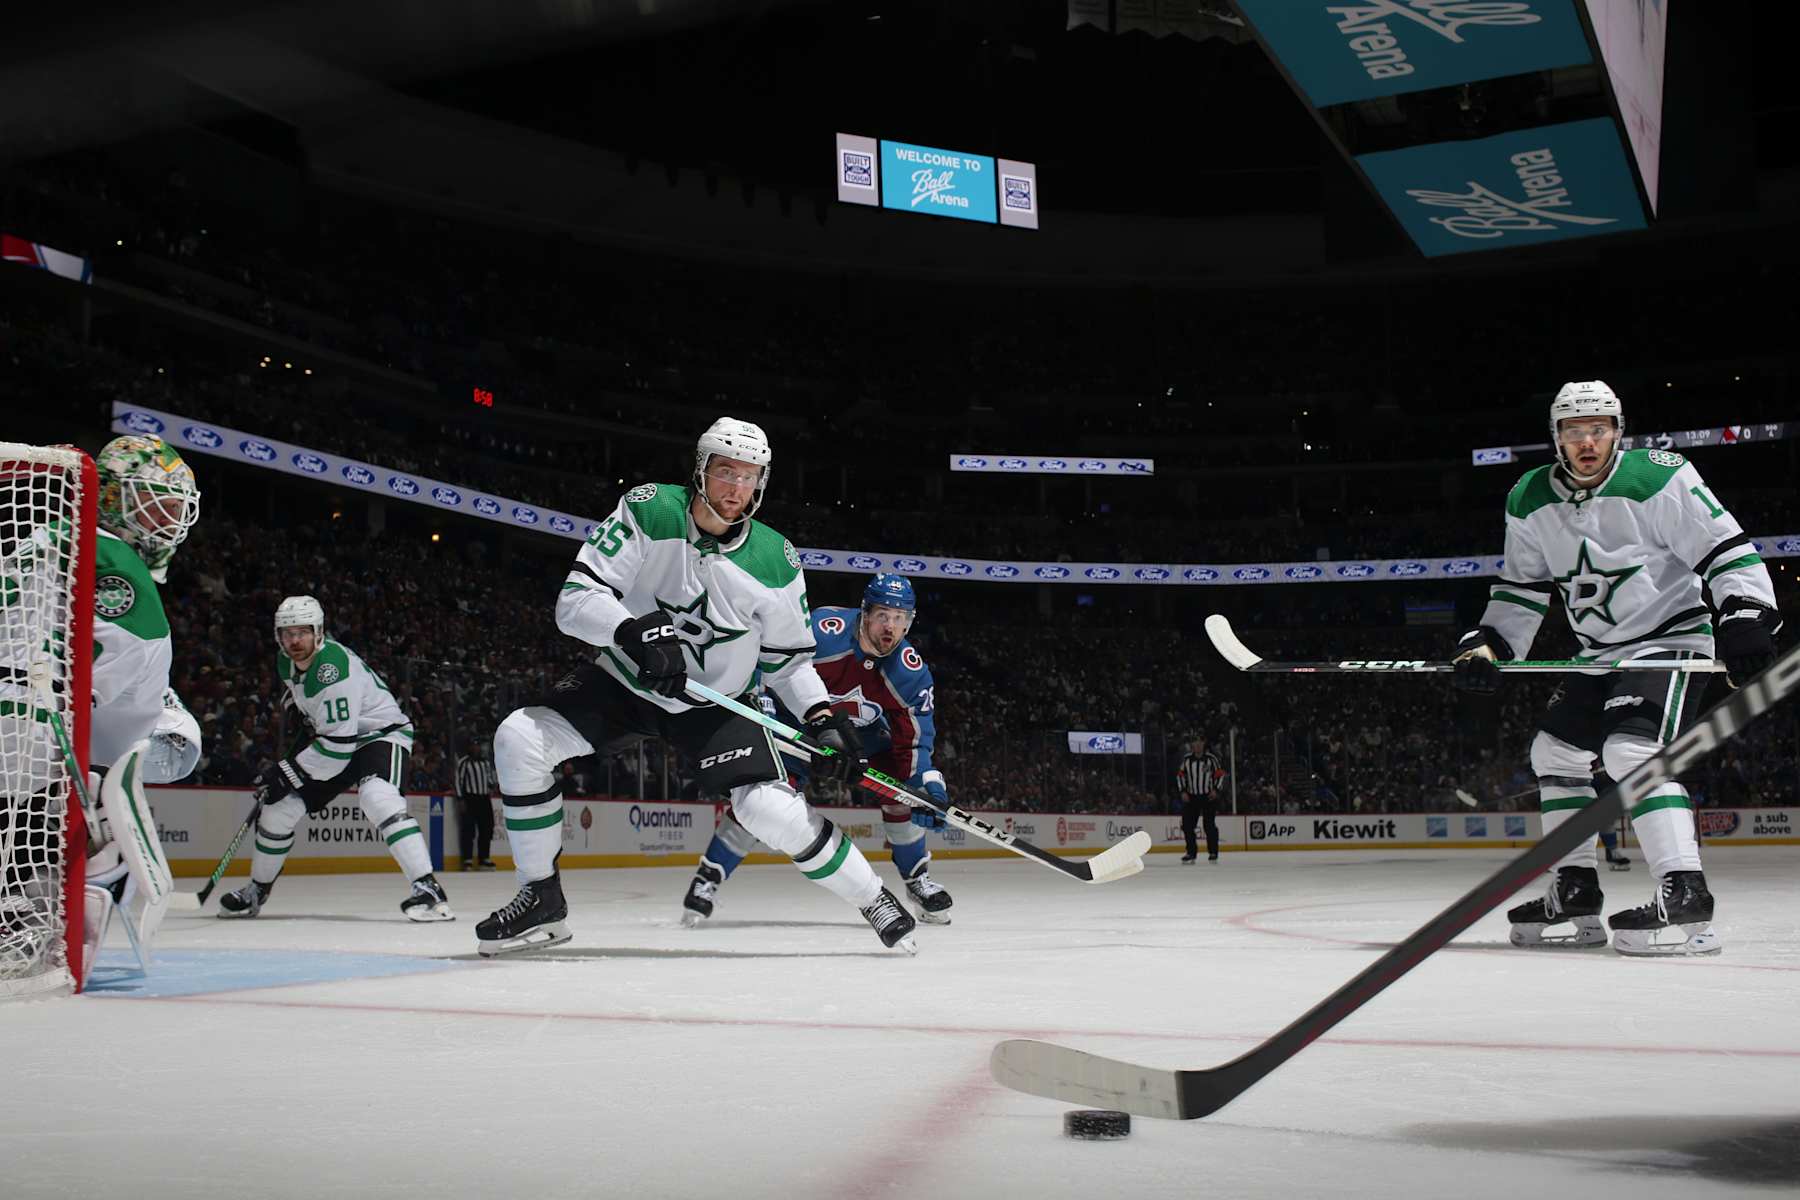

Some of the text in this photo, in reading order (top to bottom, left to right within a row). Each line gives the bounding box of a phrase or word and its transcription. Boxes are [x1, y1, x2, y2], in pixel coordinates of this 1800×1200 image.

[1327, 7, 1415, 80] Arena
[896, 148, 981, 172] WELCOME TO
[912, 169, 955, 201] Ball
[1511, 148, 1572, 207] Arena
[930, 191, 969, 208] Arena
[1406, 181, 1590, 238] Ball
[1338, 660, 1427, 670] CCM
[324, 697, 350, 724] 18
[1094, 736, 1121, 751] Ford
[698, 746, 753, 770] CCM
[629, 805, 692, 832] Quantum
[953, 810, 1014, 843] CCM
[1313, 819, 1396, 839] Kiewit
[1753, 825, 1791, 834] above
[1755, 812, 1788, 823] a sub
